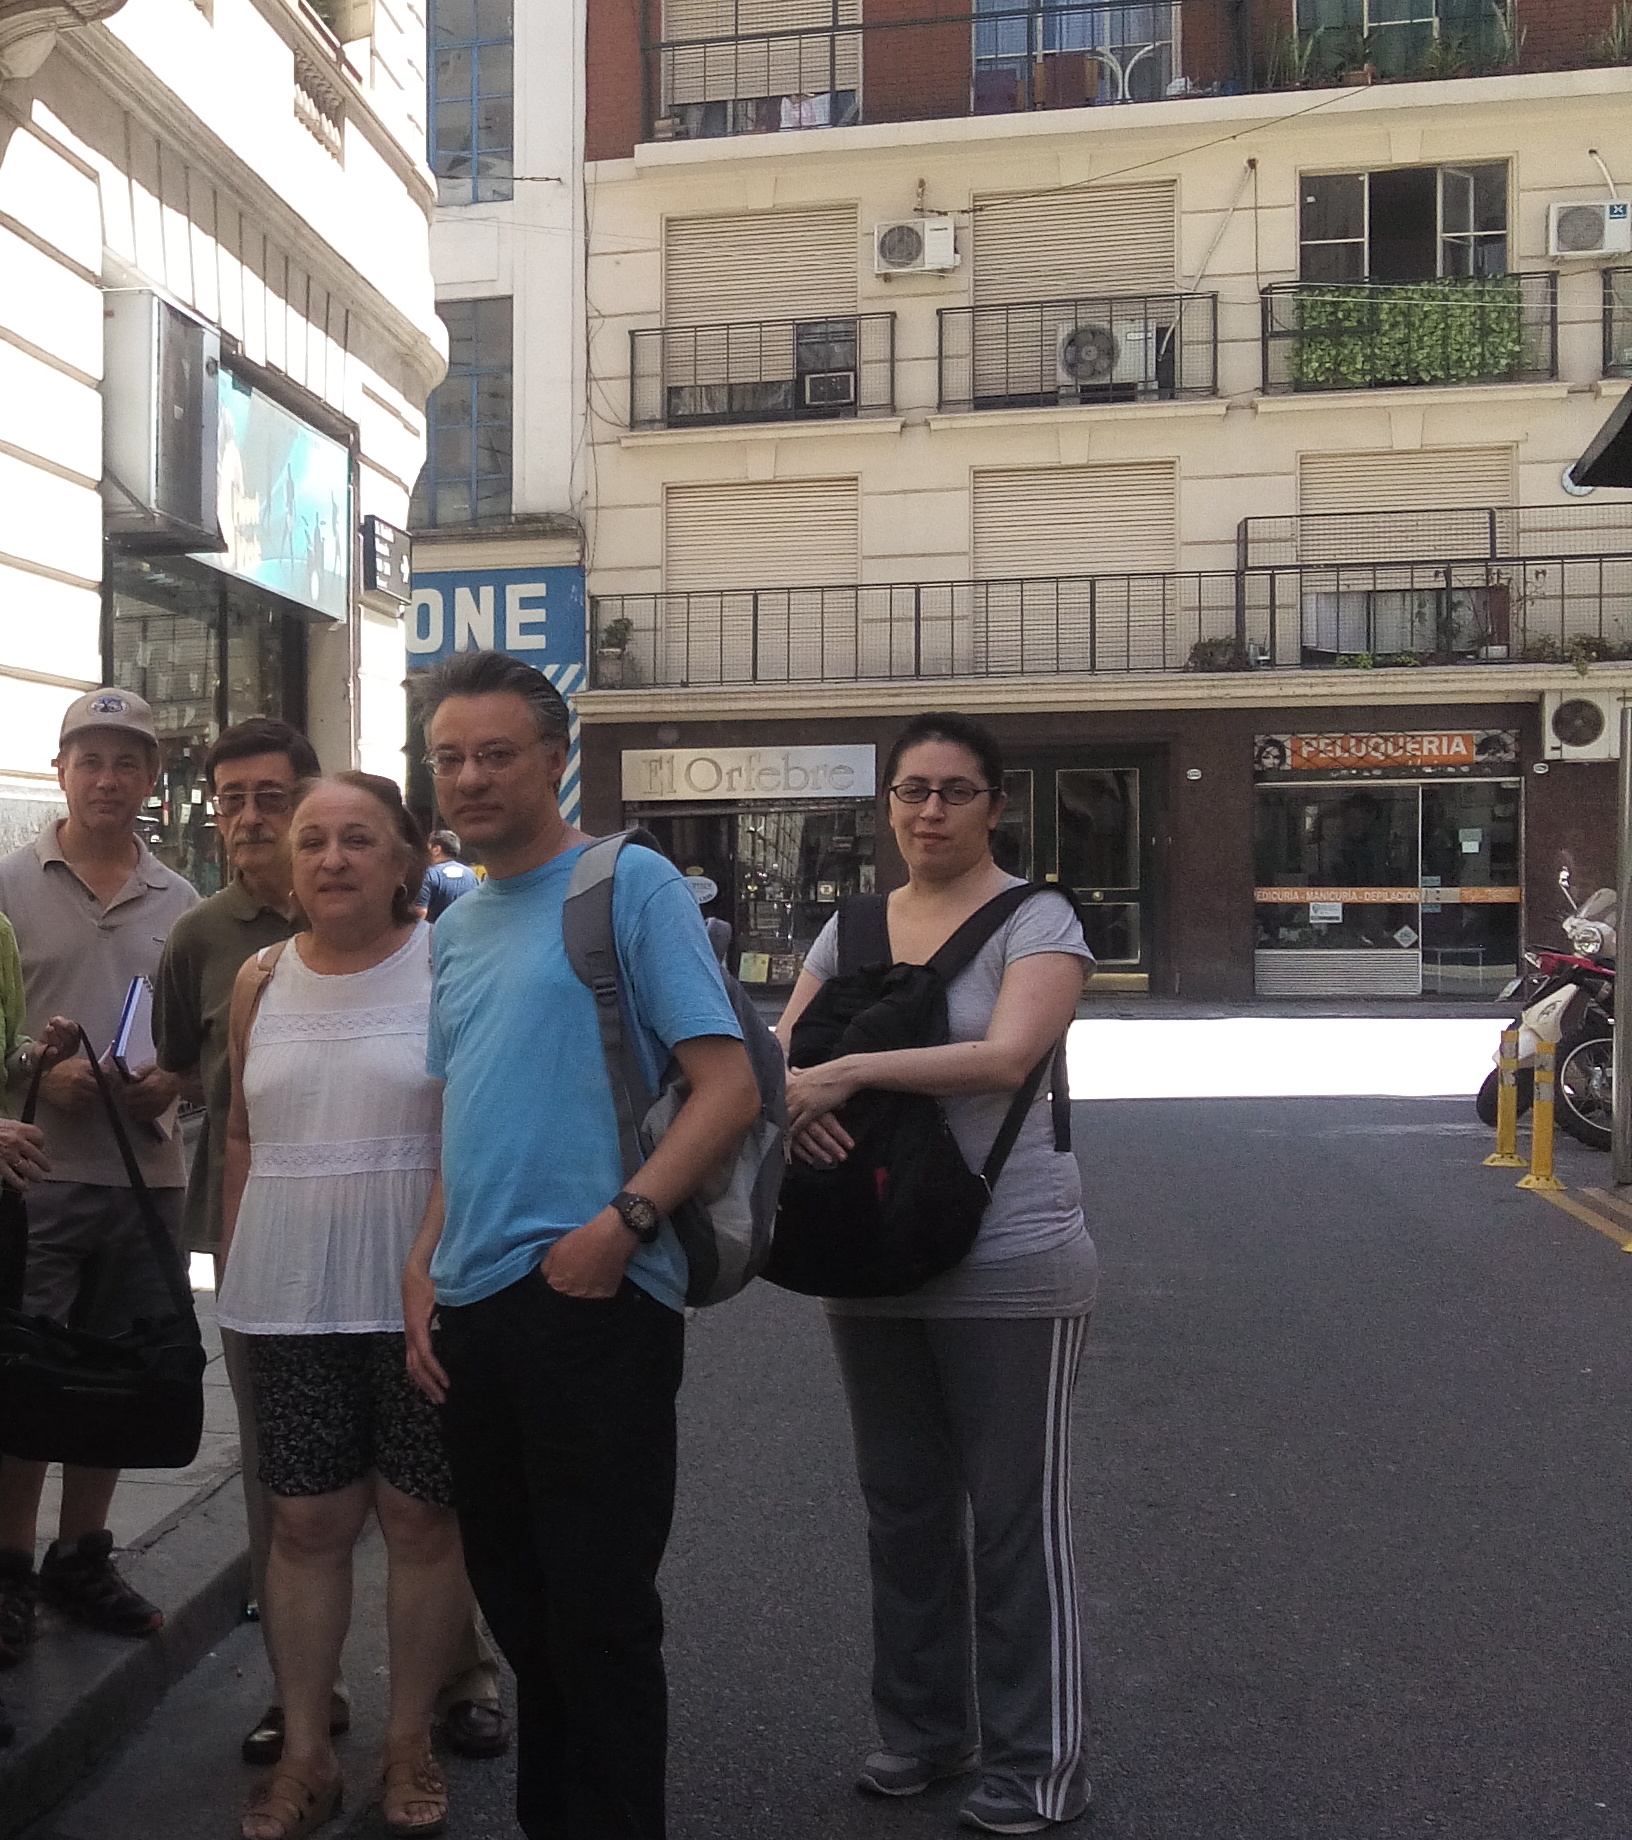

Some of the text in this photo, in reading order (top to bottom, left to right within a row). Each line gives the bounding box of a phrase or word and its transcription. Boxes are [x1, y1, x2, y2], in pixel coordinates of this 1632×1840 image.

[404, 582, 546, 654] ONE
[1300, 735, 1468, 760] PELUQUERIA
[642, 753, 855, 796] El Orfebre
